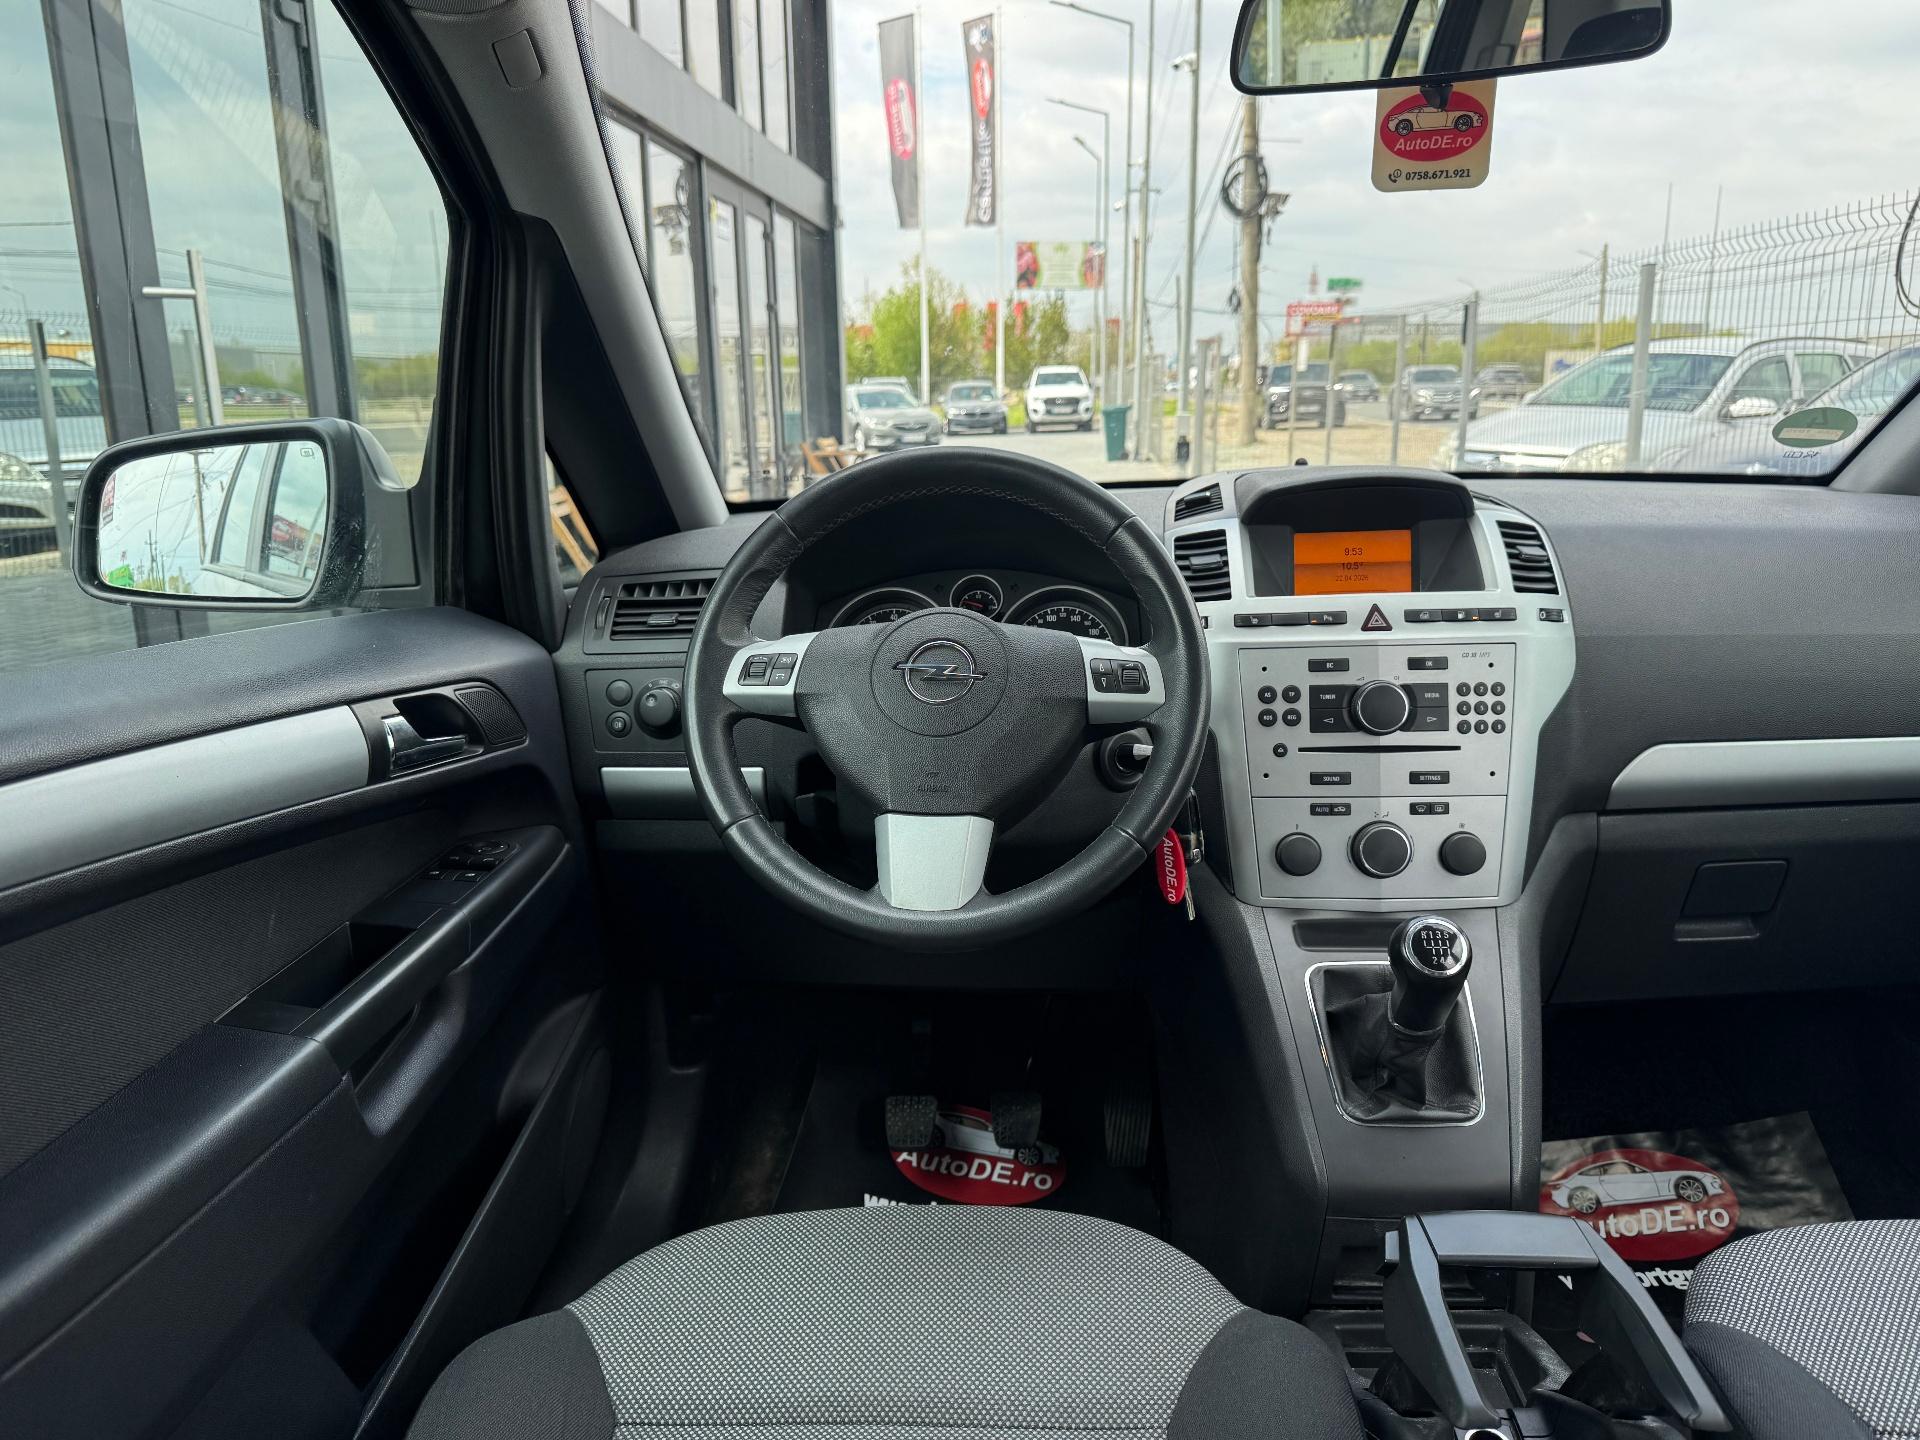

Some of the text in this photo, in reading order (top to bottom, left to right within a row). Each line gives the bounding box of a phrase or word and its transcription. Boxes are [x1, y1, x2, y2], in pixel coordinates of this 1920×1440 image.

[1394, 135, 1473, 152] AutoDE.ro
[1405, 168, 1471, 181] 0758.671.921
[1088, 628, 1100, 636] 180
[1315, 805, 1329, 813] AUTO
[1163, 836, 1178, 902] AutoDE.ro
[896, 1151, 1053, 1190] AutoDE.ro
